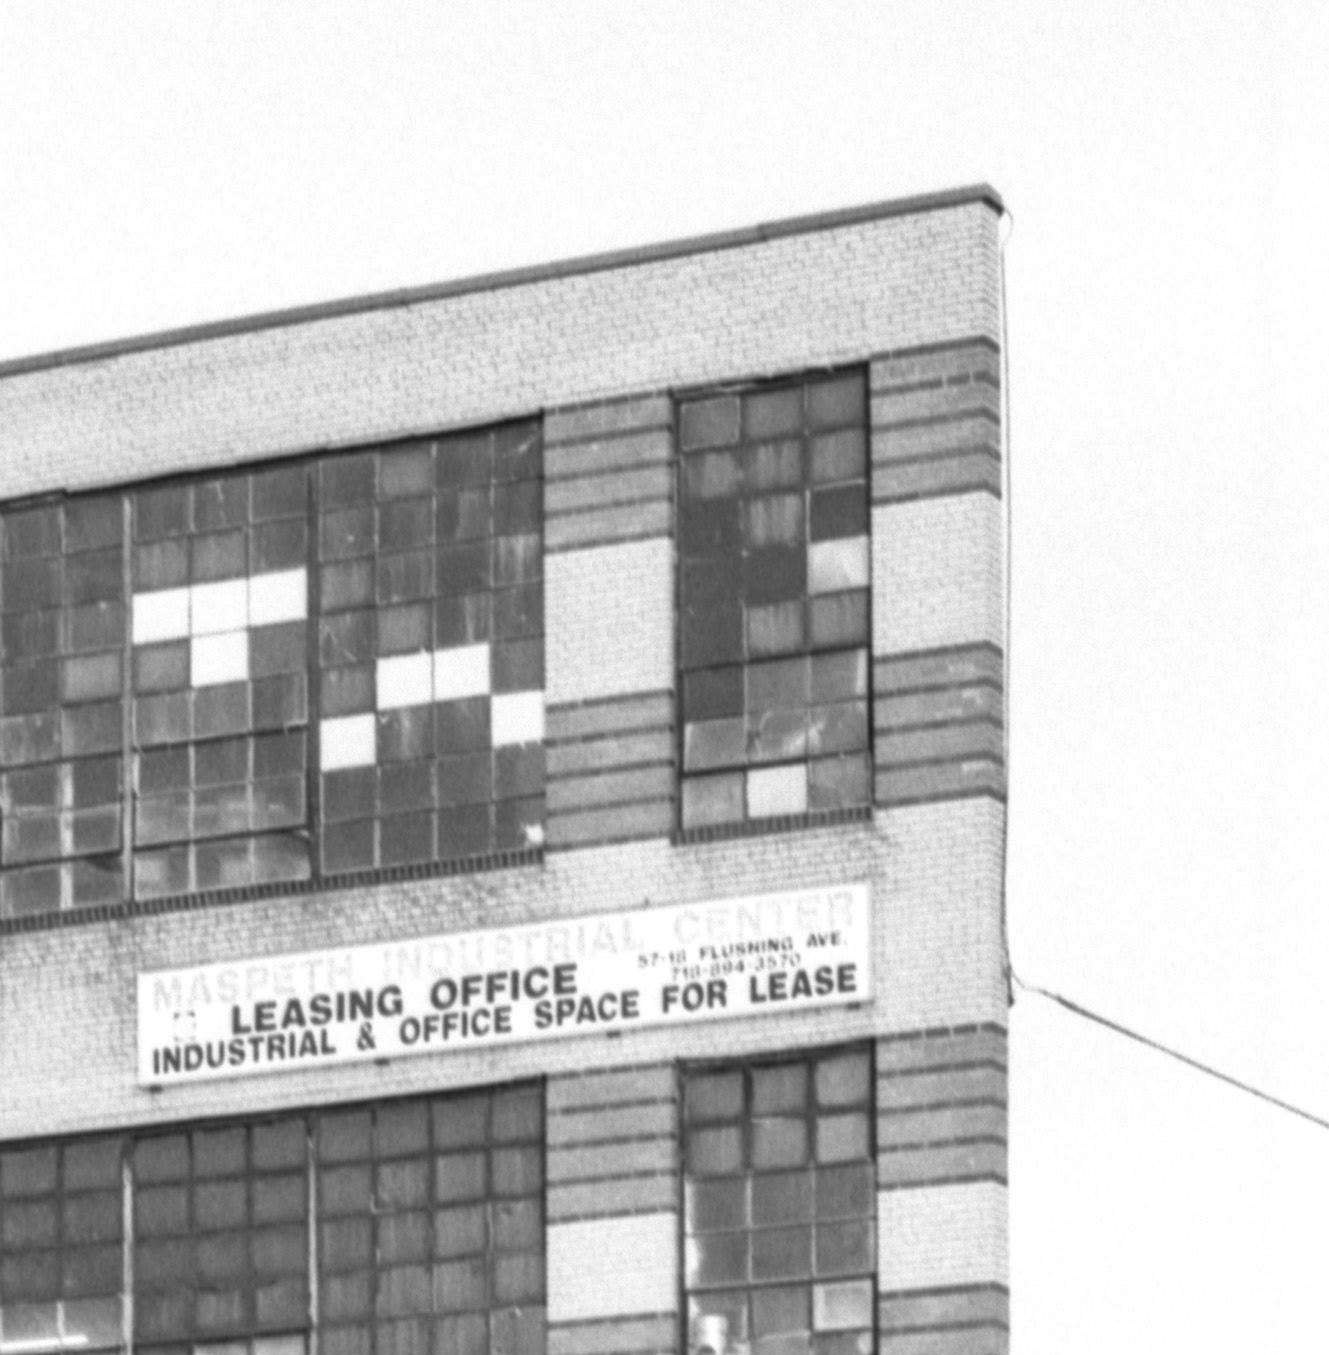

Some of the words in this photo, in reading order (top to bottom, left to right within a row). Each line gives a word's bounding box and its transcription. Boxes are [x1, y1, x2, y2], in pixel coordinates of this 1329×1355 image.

[153, 954, 352, 1010] MASPETH
[383, 917, 644, 979] INDUSTRIAL
[675, 890, 854, 944] CENTER
[700, 935, 794, 960] FLUSHING
[153, 1028, 336, 1075] INDUSTRIAL
[357, 1021, 376, 1050] &
[399, 1006, 512, 1045] OFFICE
[534, 990, 640, 1028] SPACE
[661, 979, 728, 1014] FOR
[749, 963, 858, 1004] LEASE
[231, 985, 404, 1035] LEASING
[430, 962, 578, 1011] OFFICE
